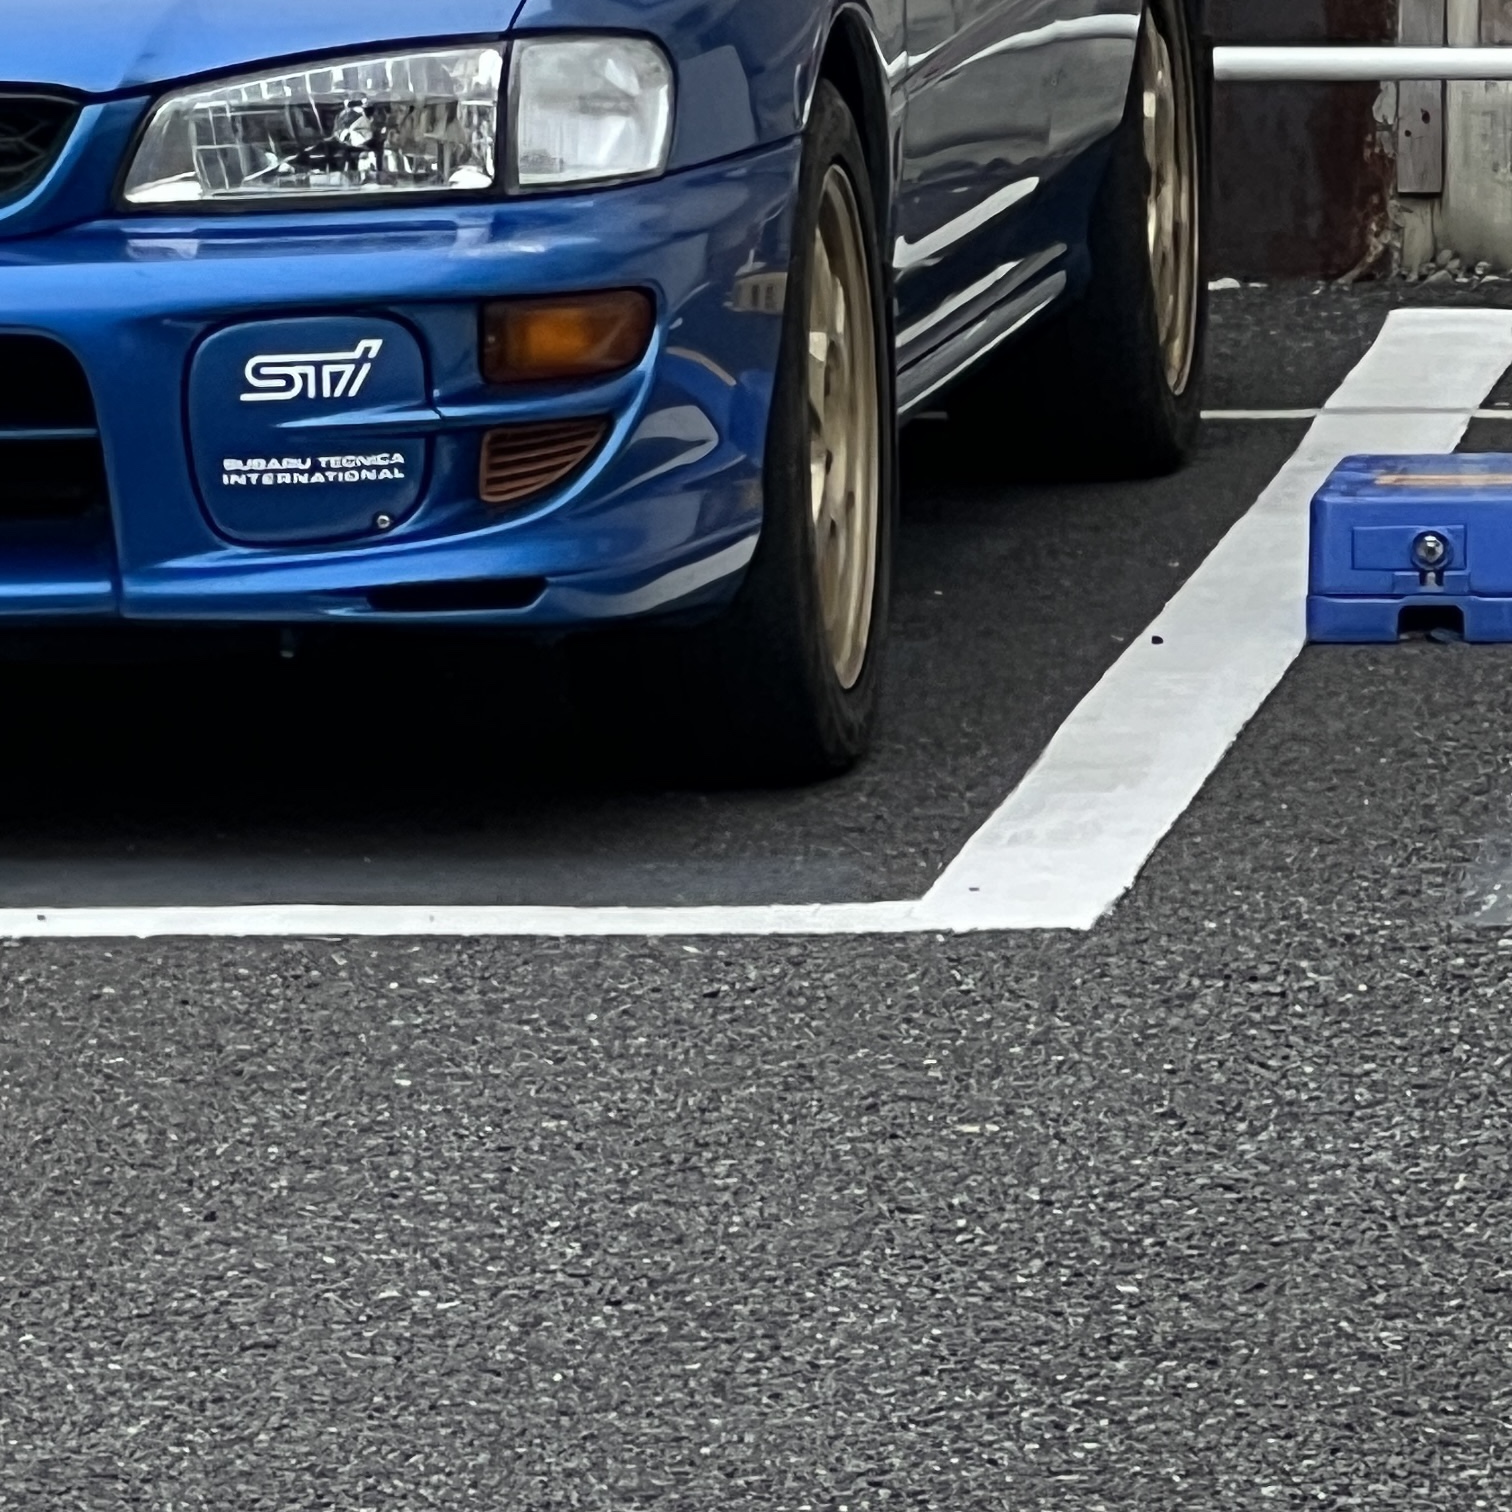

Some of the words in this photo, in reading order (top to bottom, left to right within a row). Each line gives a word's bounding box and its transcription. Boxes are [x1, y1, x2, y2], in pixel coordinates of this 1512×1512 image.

[223, 458, 312, 471] SUBARU
[317, 453, 404, 469] TECNICA
[223, 468, 404, 486] INTERNATIONAL
